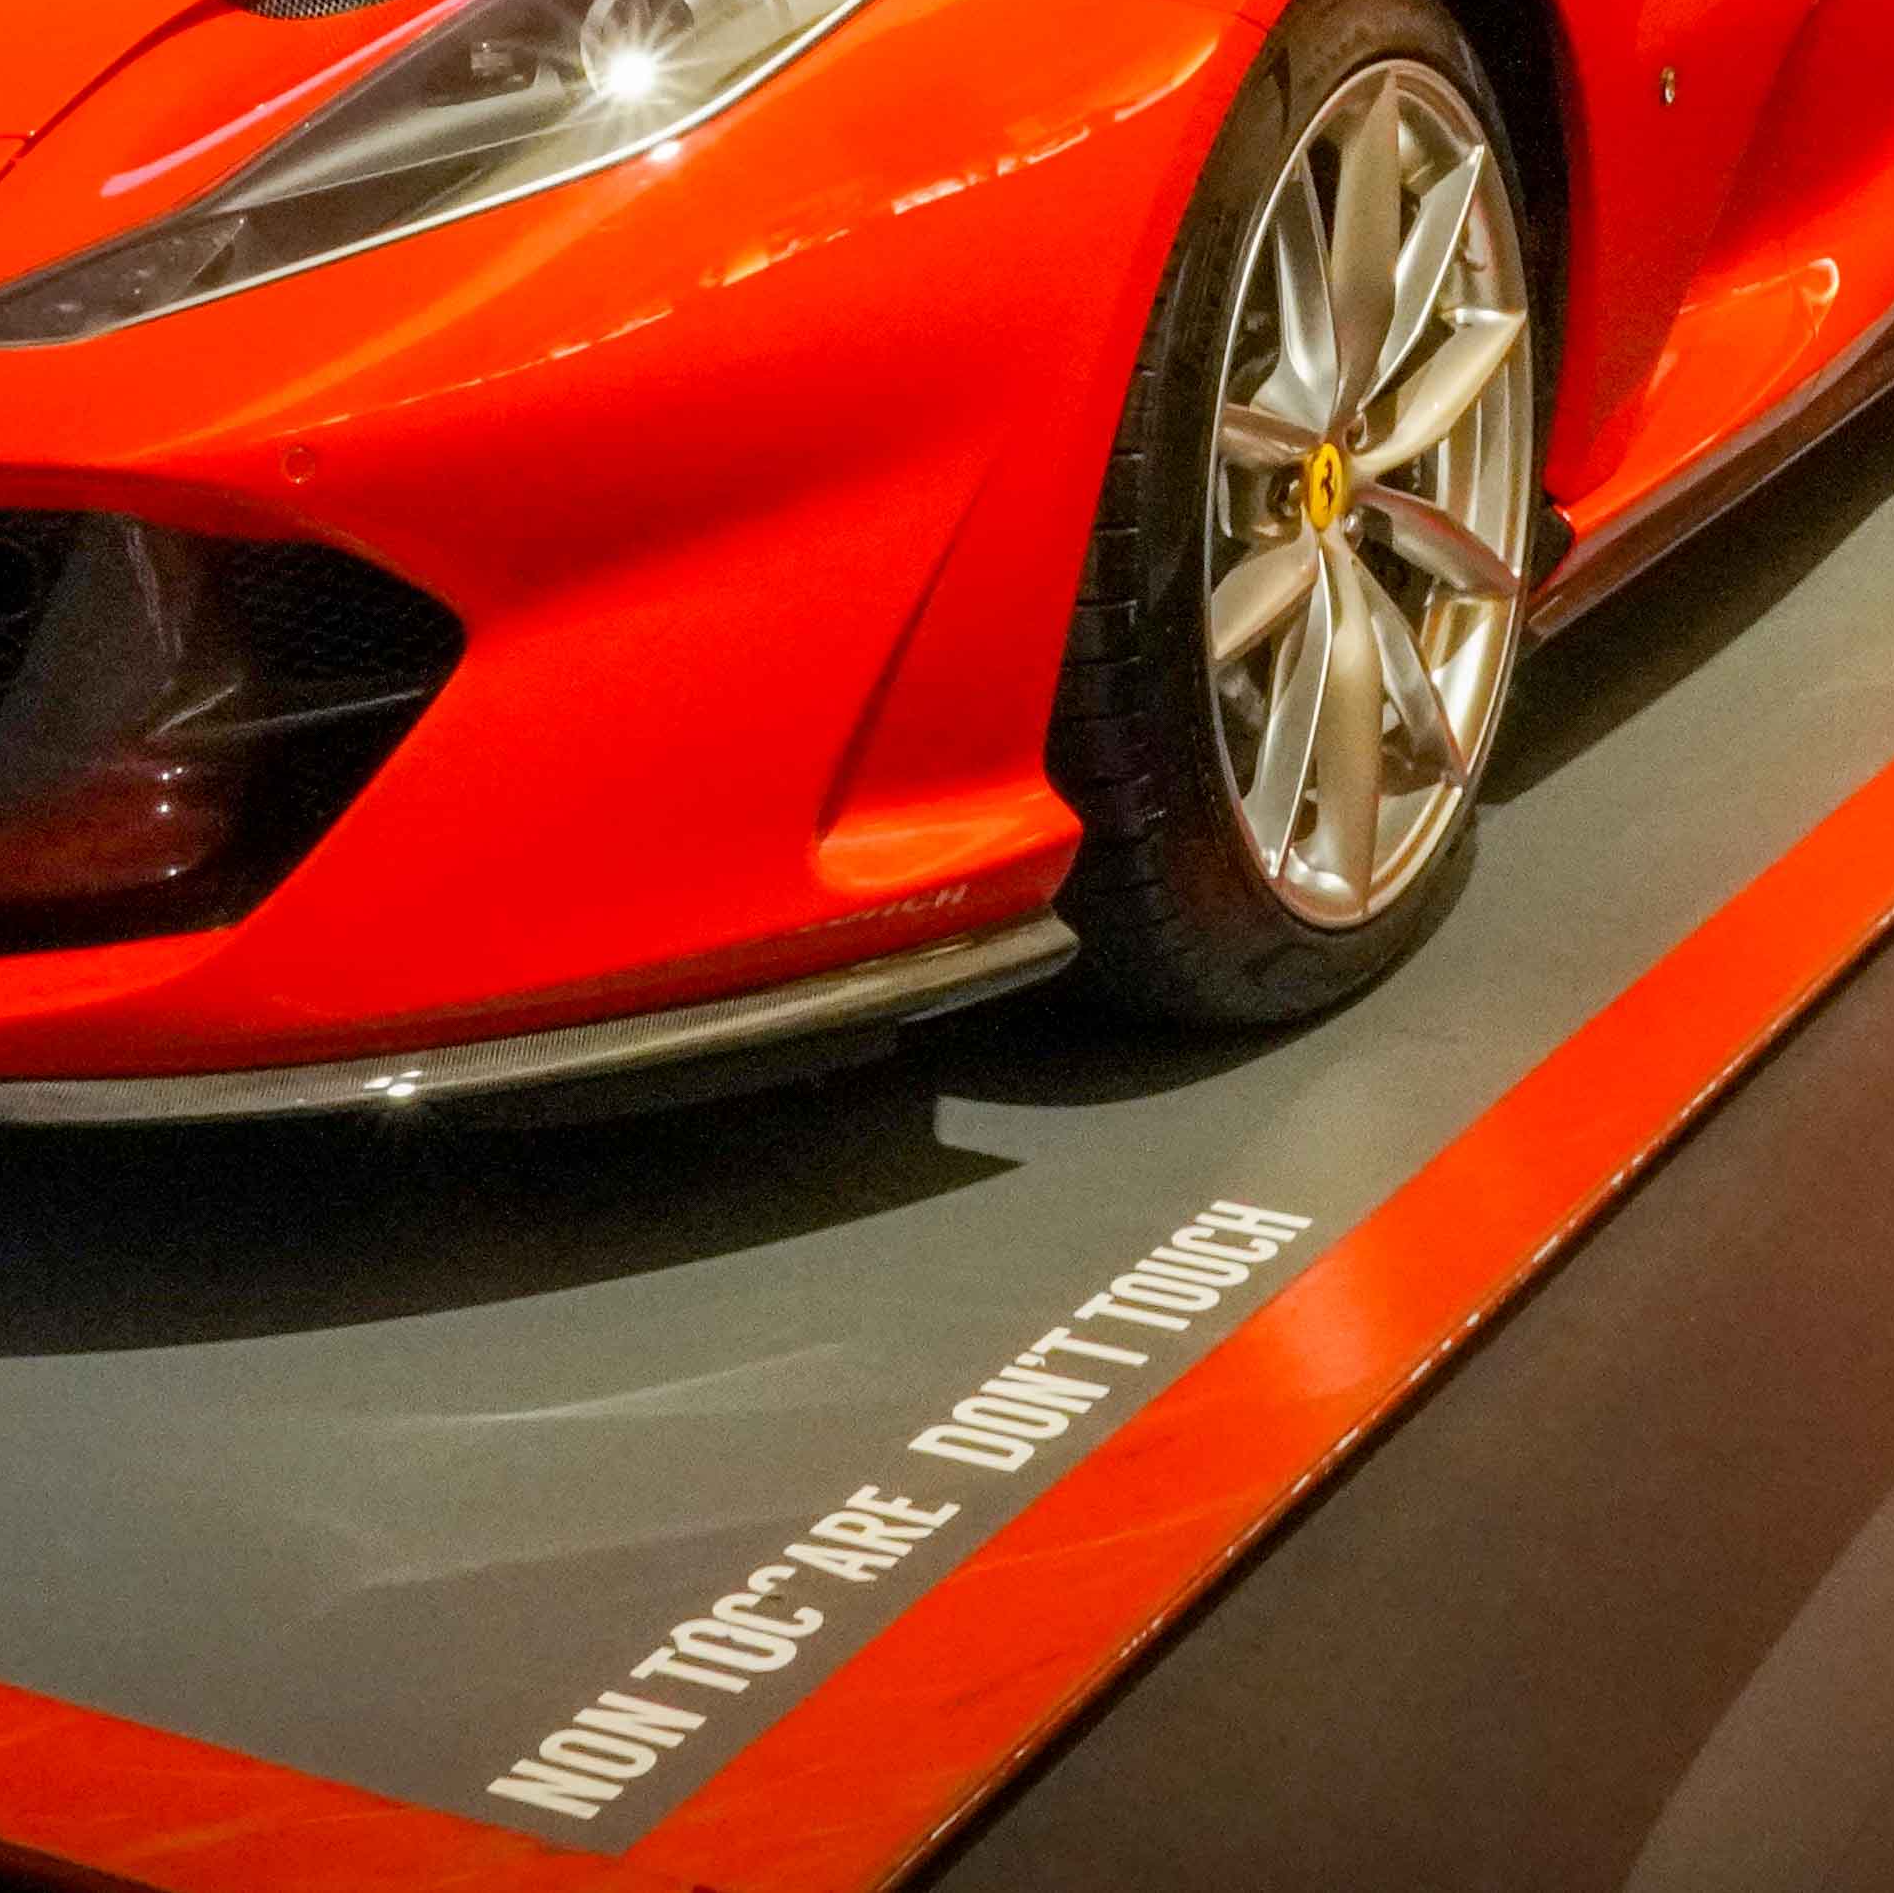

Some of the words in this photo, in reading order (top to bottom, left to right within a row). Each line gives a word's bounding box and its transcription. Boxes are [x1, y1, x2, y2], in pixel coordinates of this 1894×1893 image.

[486, 1690, 708, 1821] NON
[907, 1326, 1151, 1473] DON'T
[1073, 1200, 1314, 1333] TOUCH
